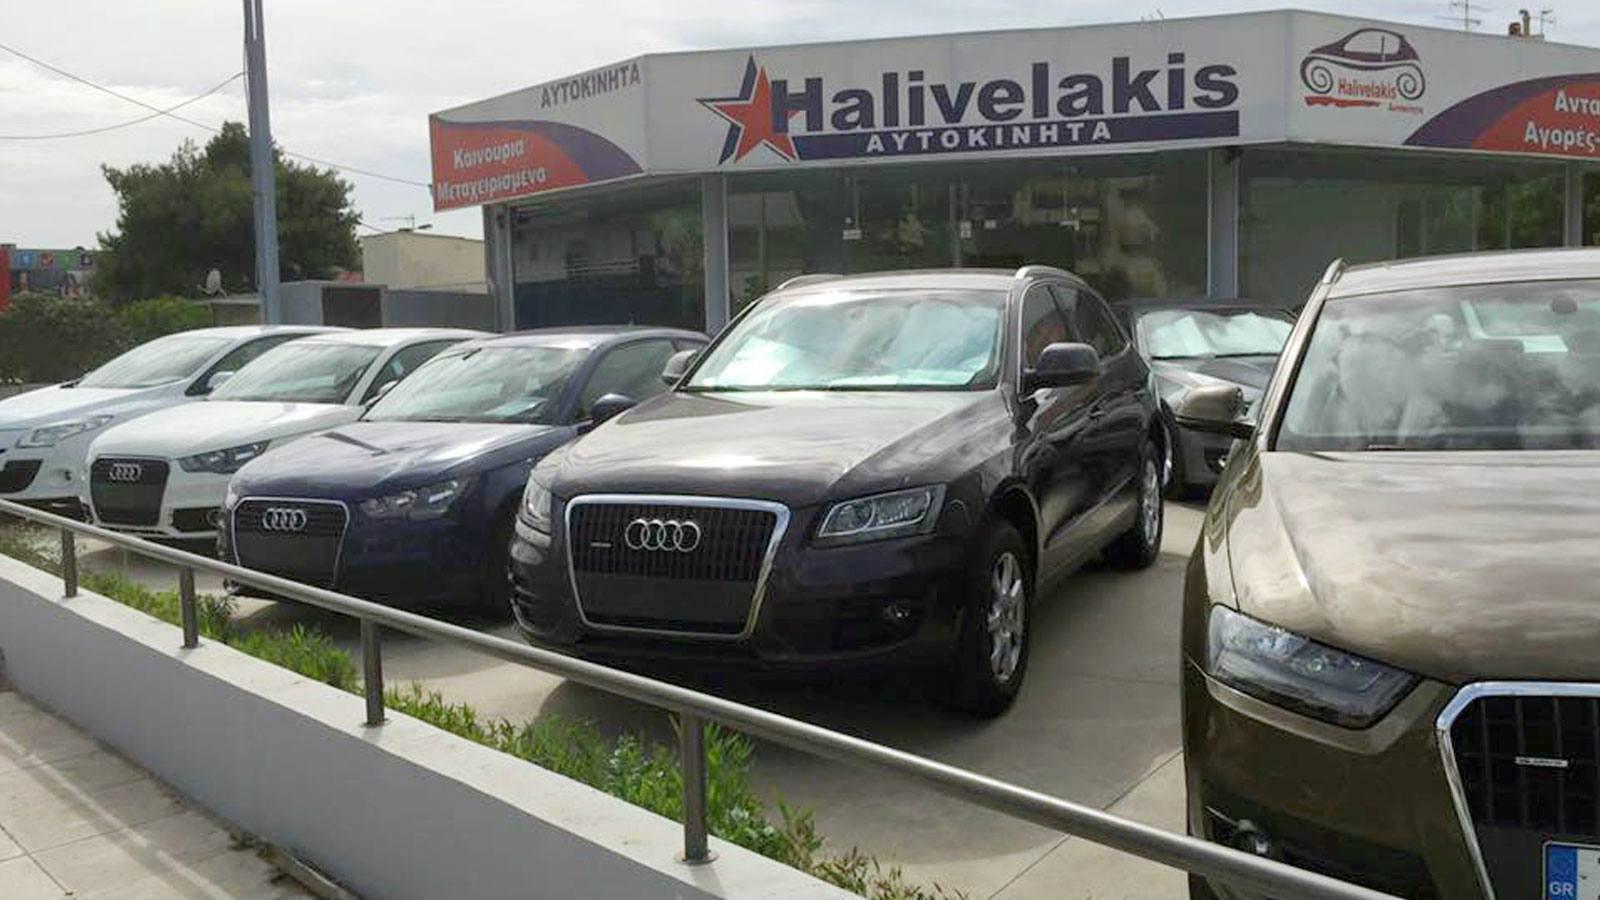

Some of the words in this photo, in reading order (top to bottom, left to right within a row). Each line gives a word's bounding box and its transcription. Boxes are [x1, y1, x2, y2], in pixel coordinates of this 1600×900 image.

[540, 62, 641, 109] ΑΥΤΟΚΙΝΗΤΑ
[770, 52, 1240, 132] Halivelakis
[1338, 77, 1398, 99] Halivelakis
[866, 120, 1112, 153] ΑΥΤΟΚΙΝΗΤΑ
[1549, 881, 1574, 897] GR
